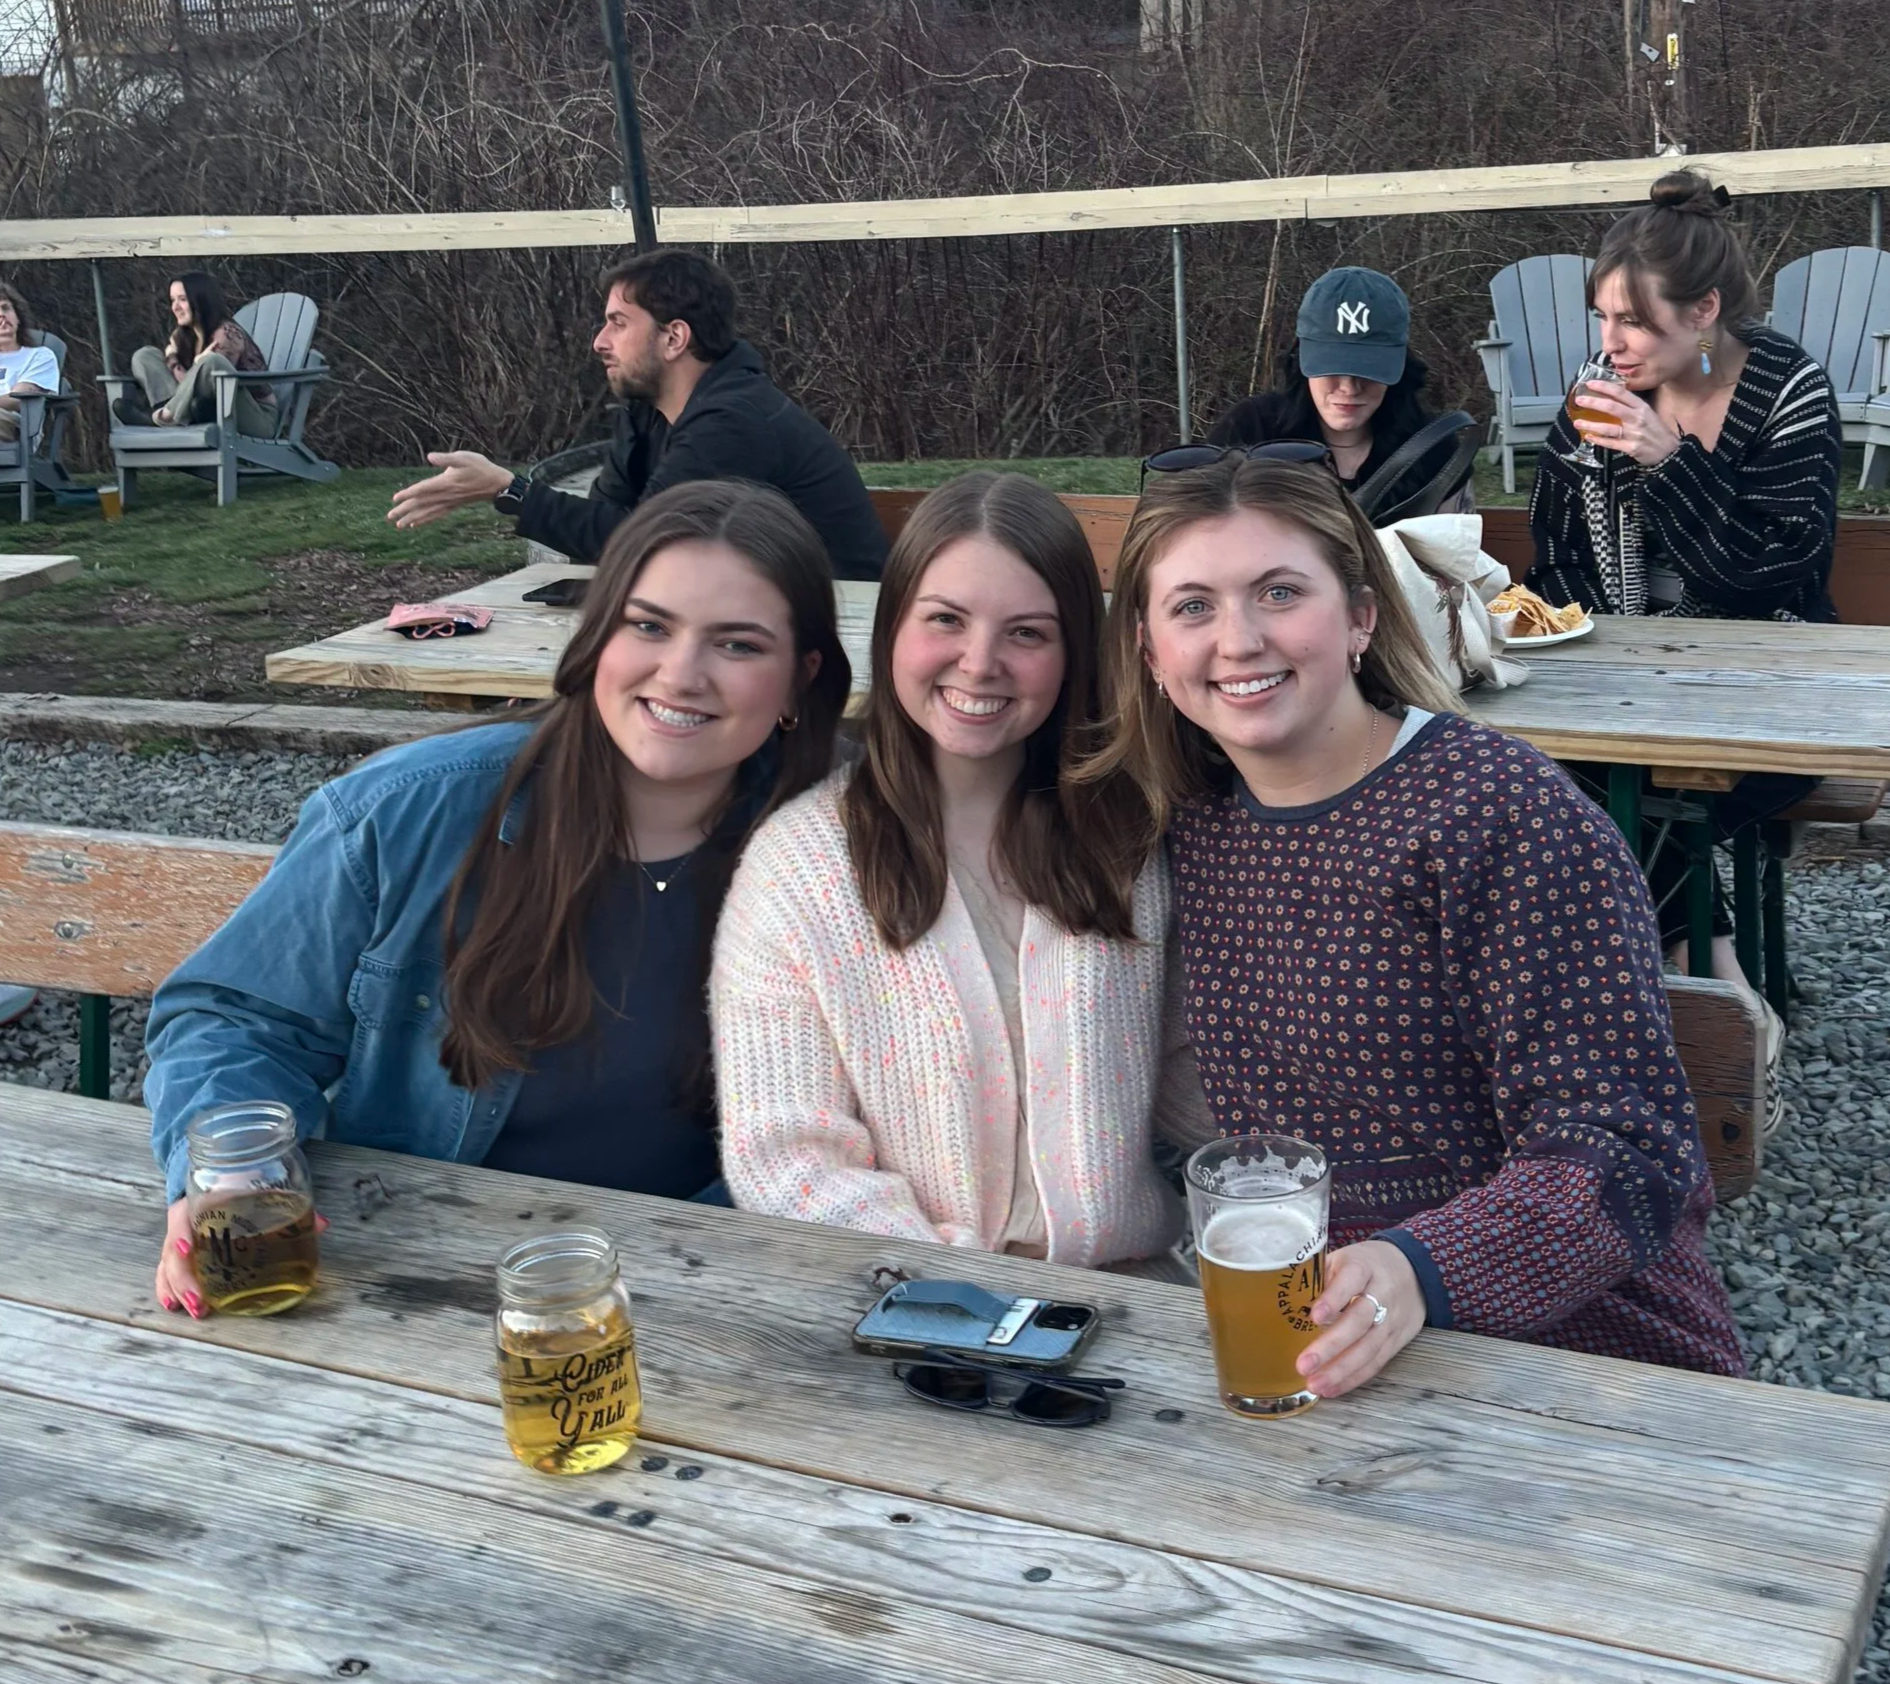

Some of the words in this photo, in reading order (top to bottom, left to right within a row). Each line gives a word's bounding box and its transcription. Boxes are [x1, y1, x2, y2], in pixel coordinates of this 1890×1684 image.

[1336, 301, 1371, 335] NY
[1293, 1317, 1319, 1333] BRE
[578, 1386, 605, 1407] FOR
[611, 1373, 628, 1396] ALL
